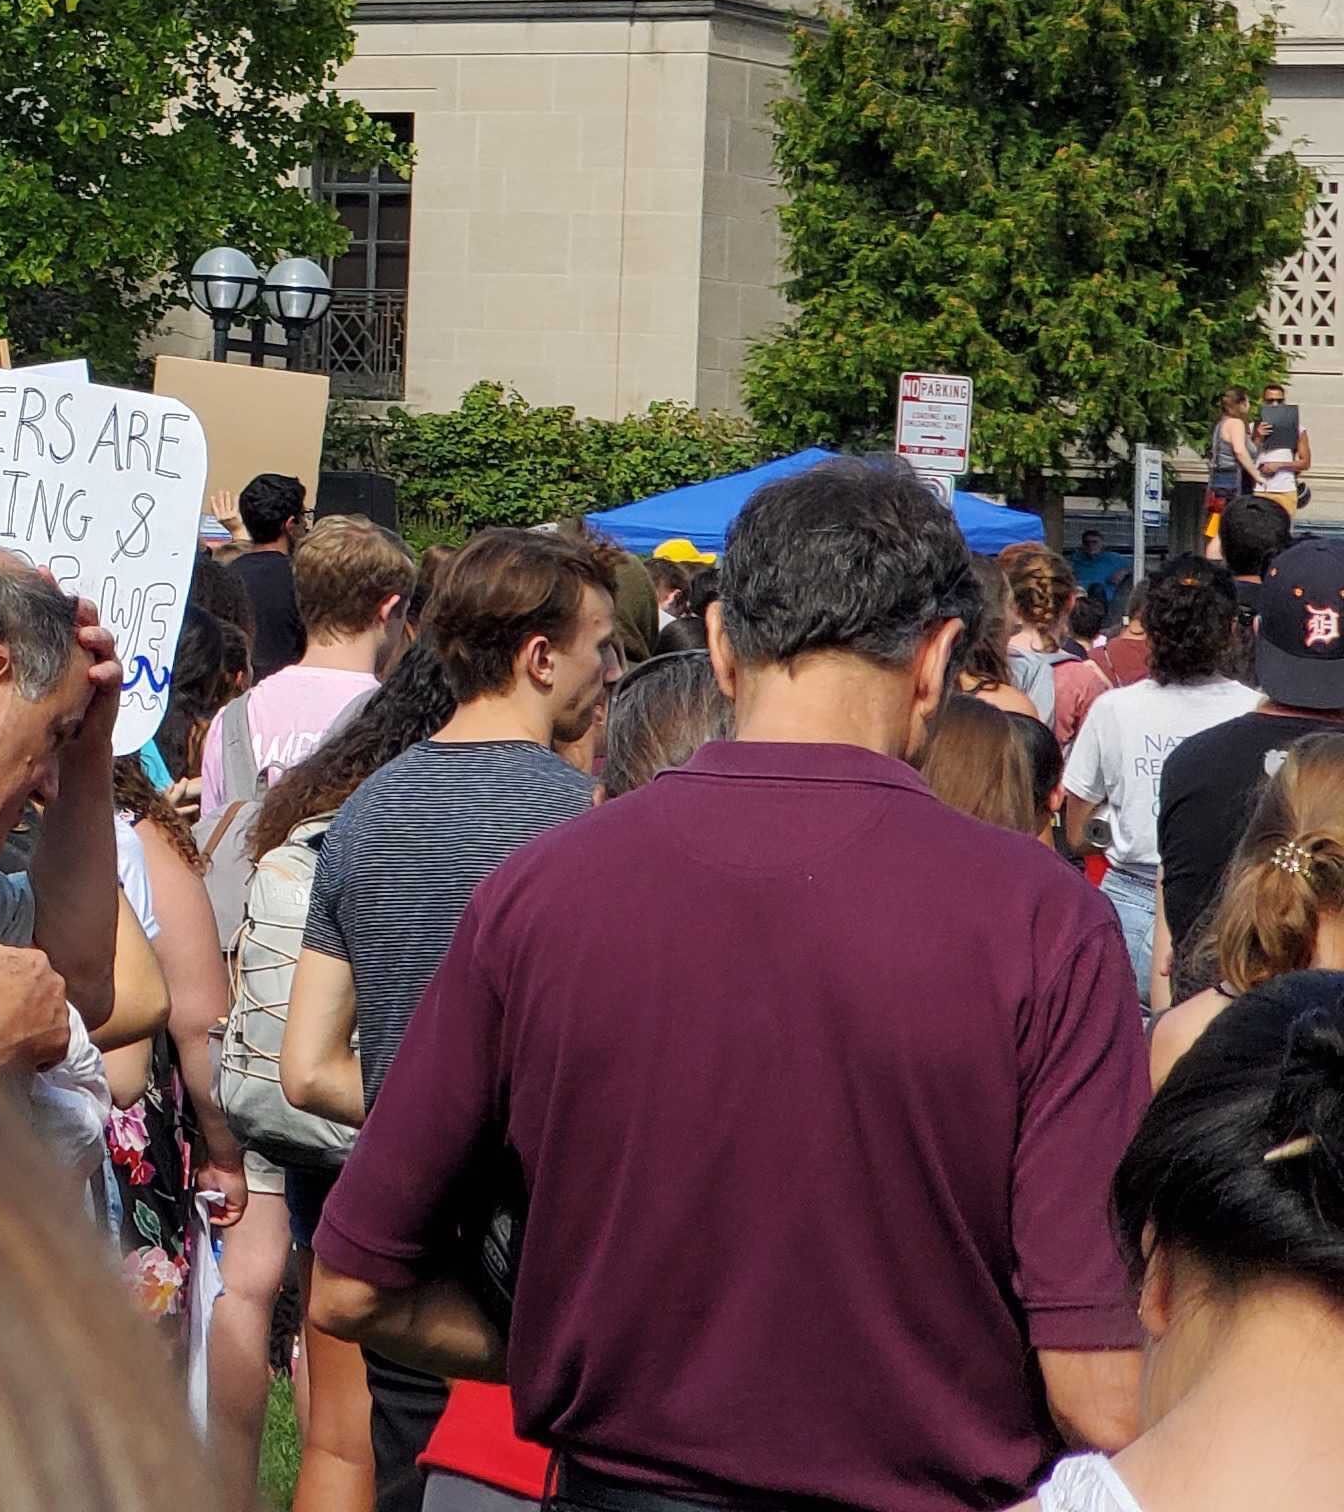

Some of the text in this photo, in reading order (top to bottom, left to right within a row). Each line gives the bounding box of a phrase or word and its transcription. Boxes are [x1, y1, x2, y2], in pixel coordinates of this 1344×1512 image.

[902, 379, 968, 400] NO PARKING
[88, 403, 191, 480] ARE
